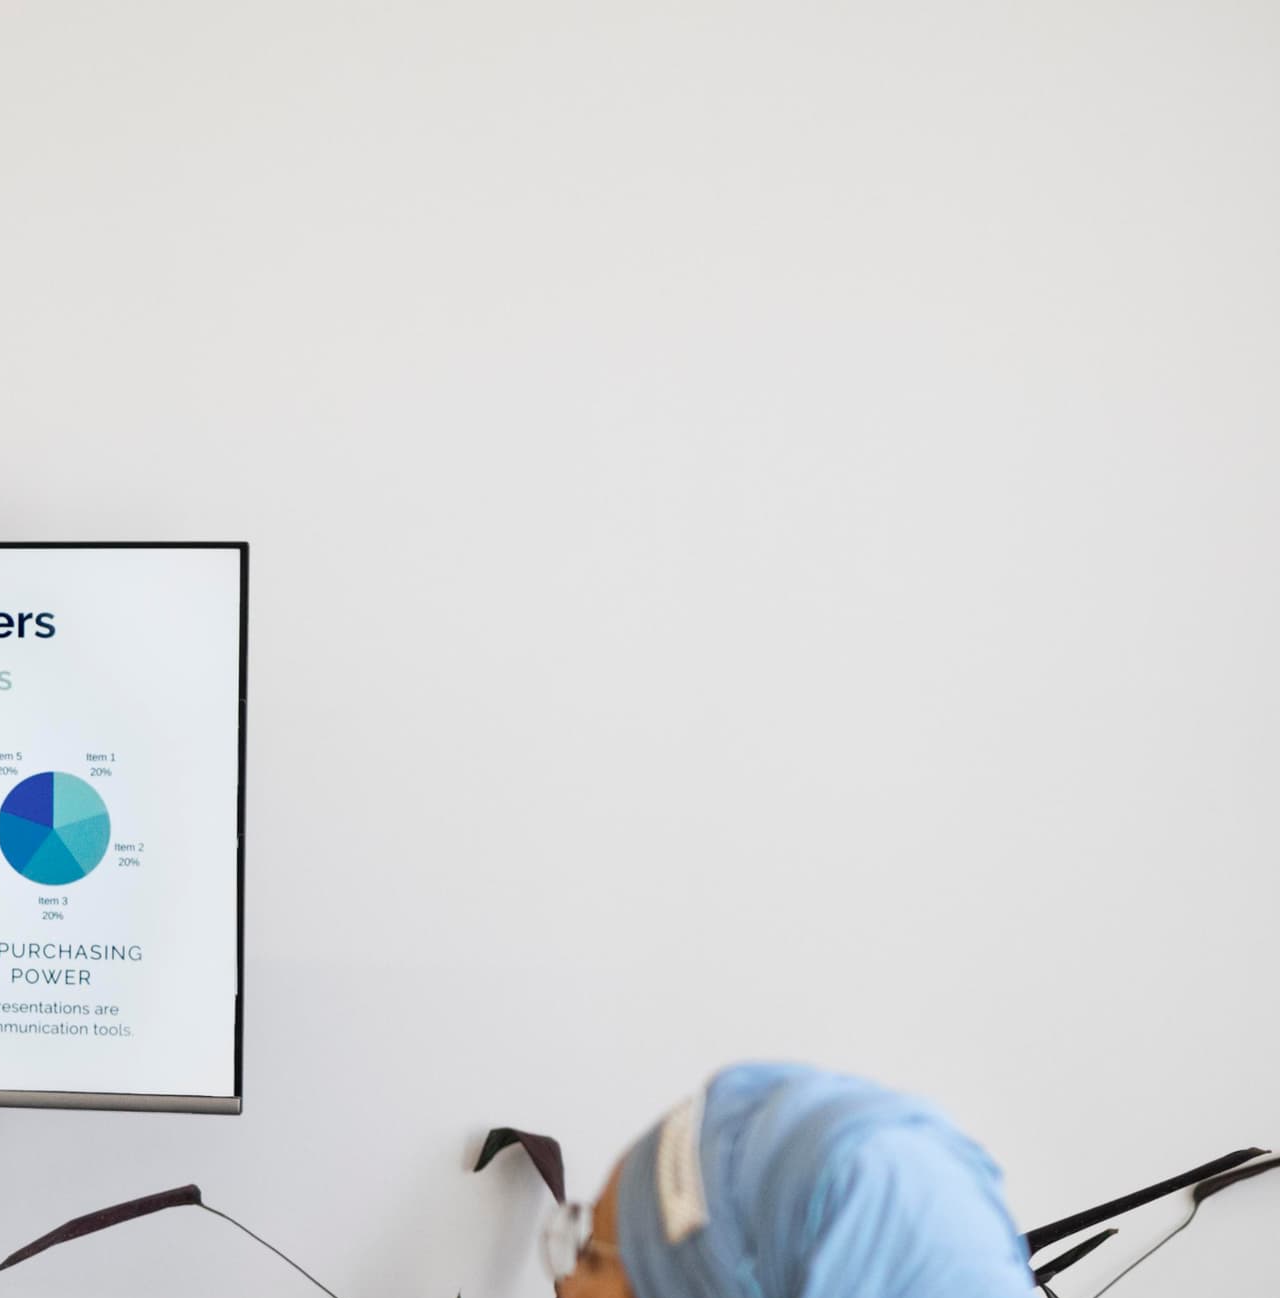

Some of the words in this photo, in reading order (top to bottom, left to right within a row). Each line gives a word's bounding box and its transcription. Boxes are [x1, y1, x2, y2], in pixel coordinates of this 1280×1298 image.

[16, 752, 22, 761] 5
[86, 752, 107, 761] Item
[110, 753, 116, 762] 1
[90, 768, 112, 777] 20%
[114, 843, 135, 852] Item
[138, 843, 144, 852] 2
[118, 858, 140, 867] 20%
[38, 896, 59, 906] Item
[62, 896, 68, 906] 3
[42, 911, 64, 920] 20%
[11, 968, 91, 986] POWER
[94, 1004, 119, 1016] are
